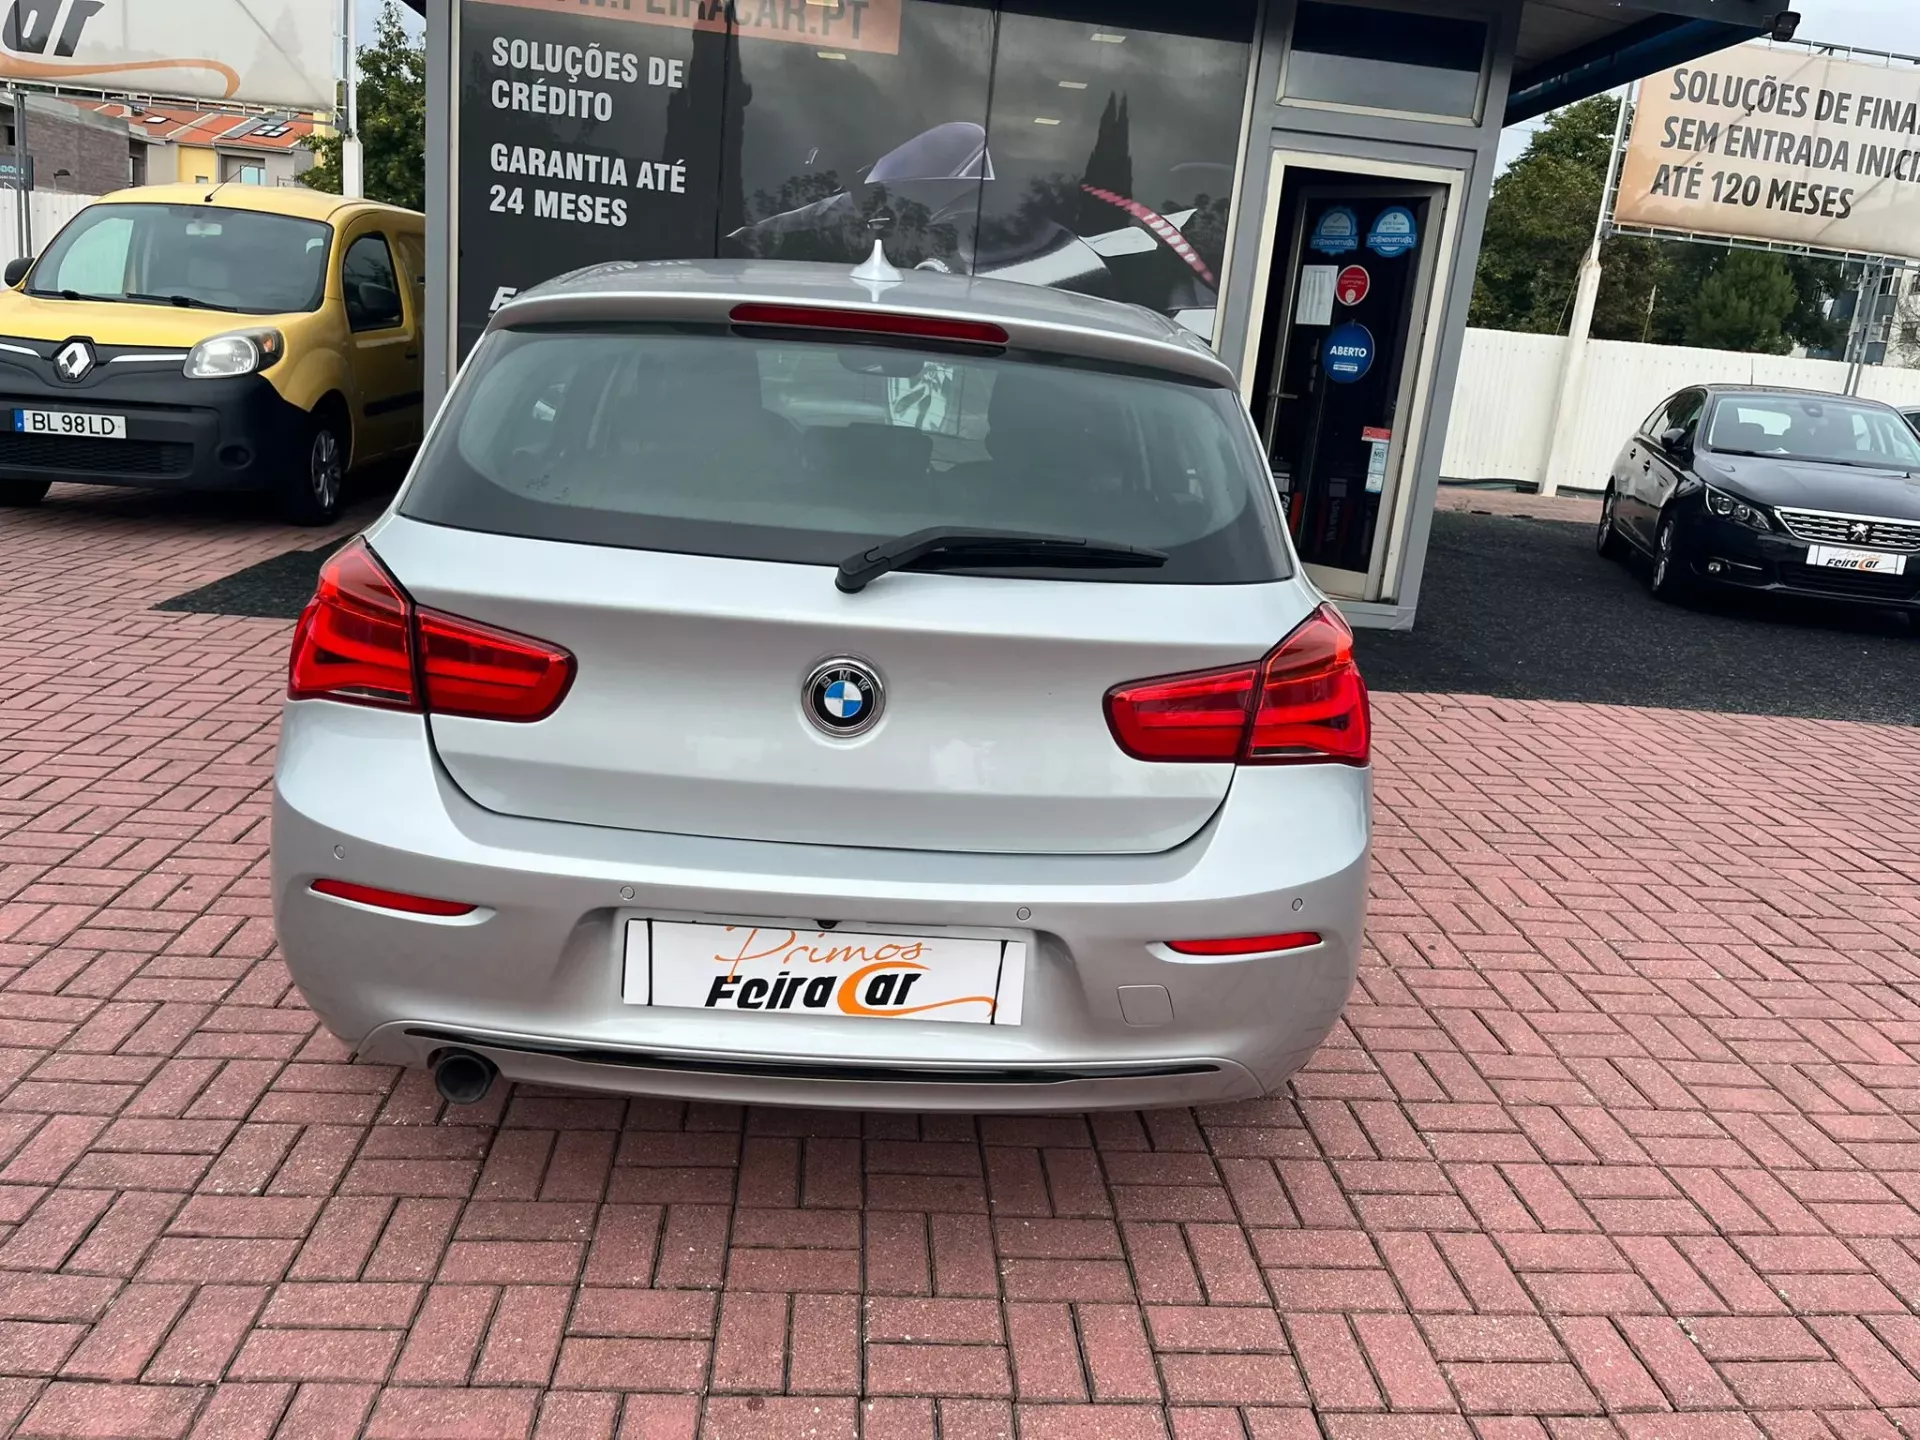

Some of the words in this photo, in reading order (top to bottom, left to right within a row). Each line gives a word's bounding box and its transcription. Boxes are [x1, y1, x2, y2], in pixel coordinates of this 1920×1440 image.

[491, 36, 638, 83] SOLUÇÕES
[648, 57, 684, 89] DE
[491, 78, 613, 122] CRÉDITO
[1670, 67, 1810, 117] SOLUÇÕES
[1814, 89, 1853, 125] DE
[1855, 95, 1920, 136] FINA
[490, 142, 628, 187] GARANTIA
[636, 159, 687, 194] ATÉ
[1660, 115, 1720, 153] SEM
[1723, 124, 1849, 172] ENTRADA
[1856, 143, 1920, 184] INICI
[489, 185, 525, 215] 24
[534, 189, 628, 227] MESES
[1650, 161, 1704, 200] ATÉ
[1711, 171, 1761, 207] 120
[1766, 178, 1854, 219] MESES
[1330, 345, 1367, 358] ABERTO
[820, 669, 870, 692] BMW
